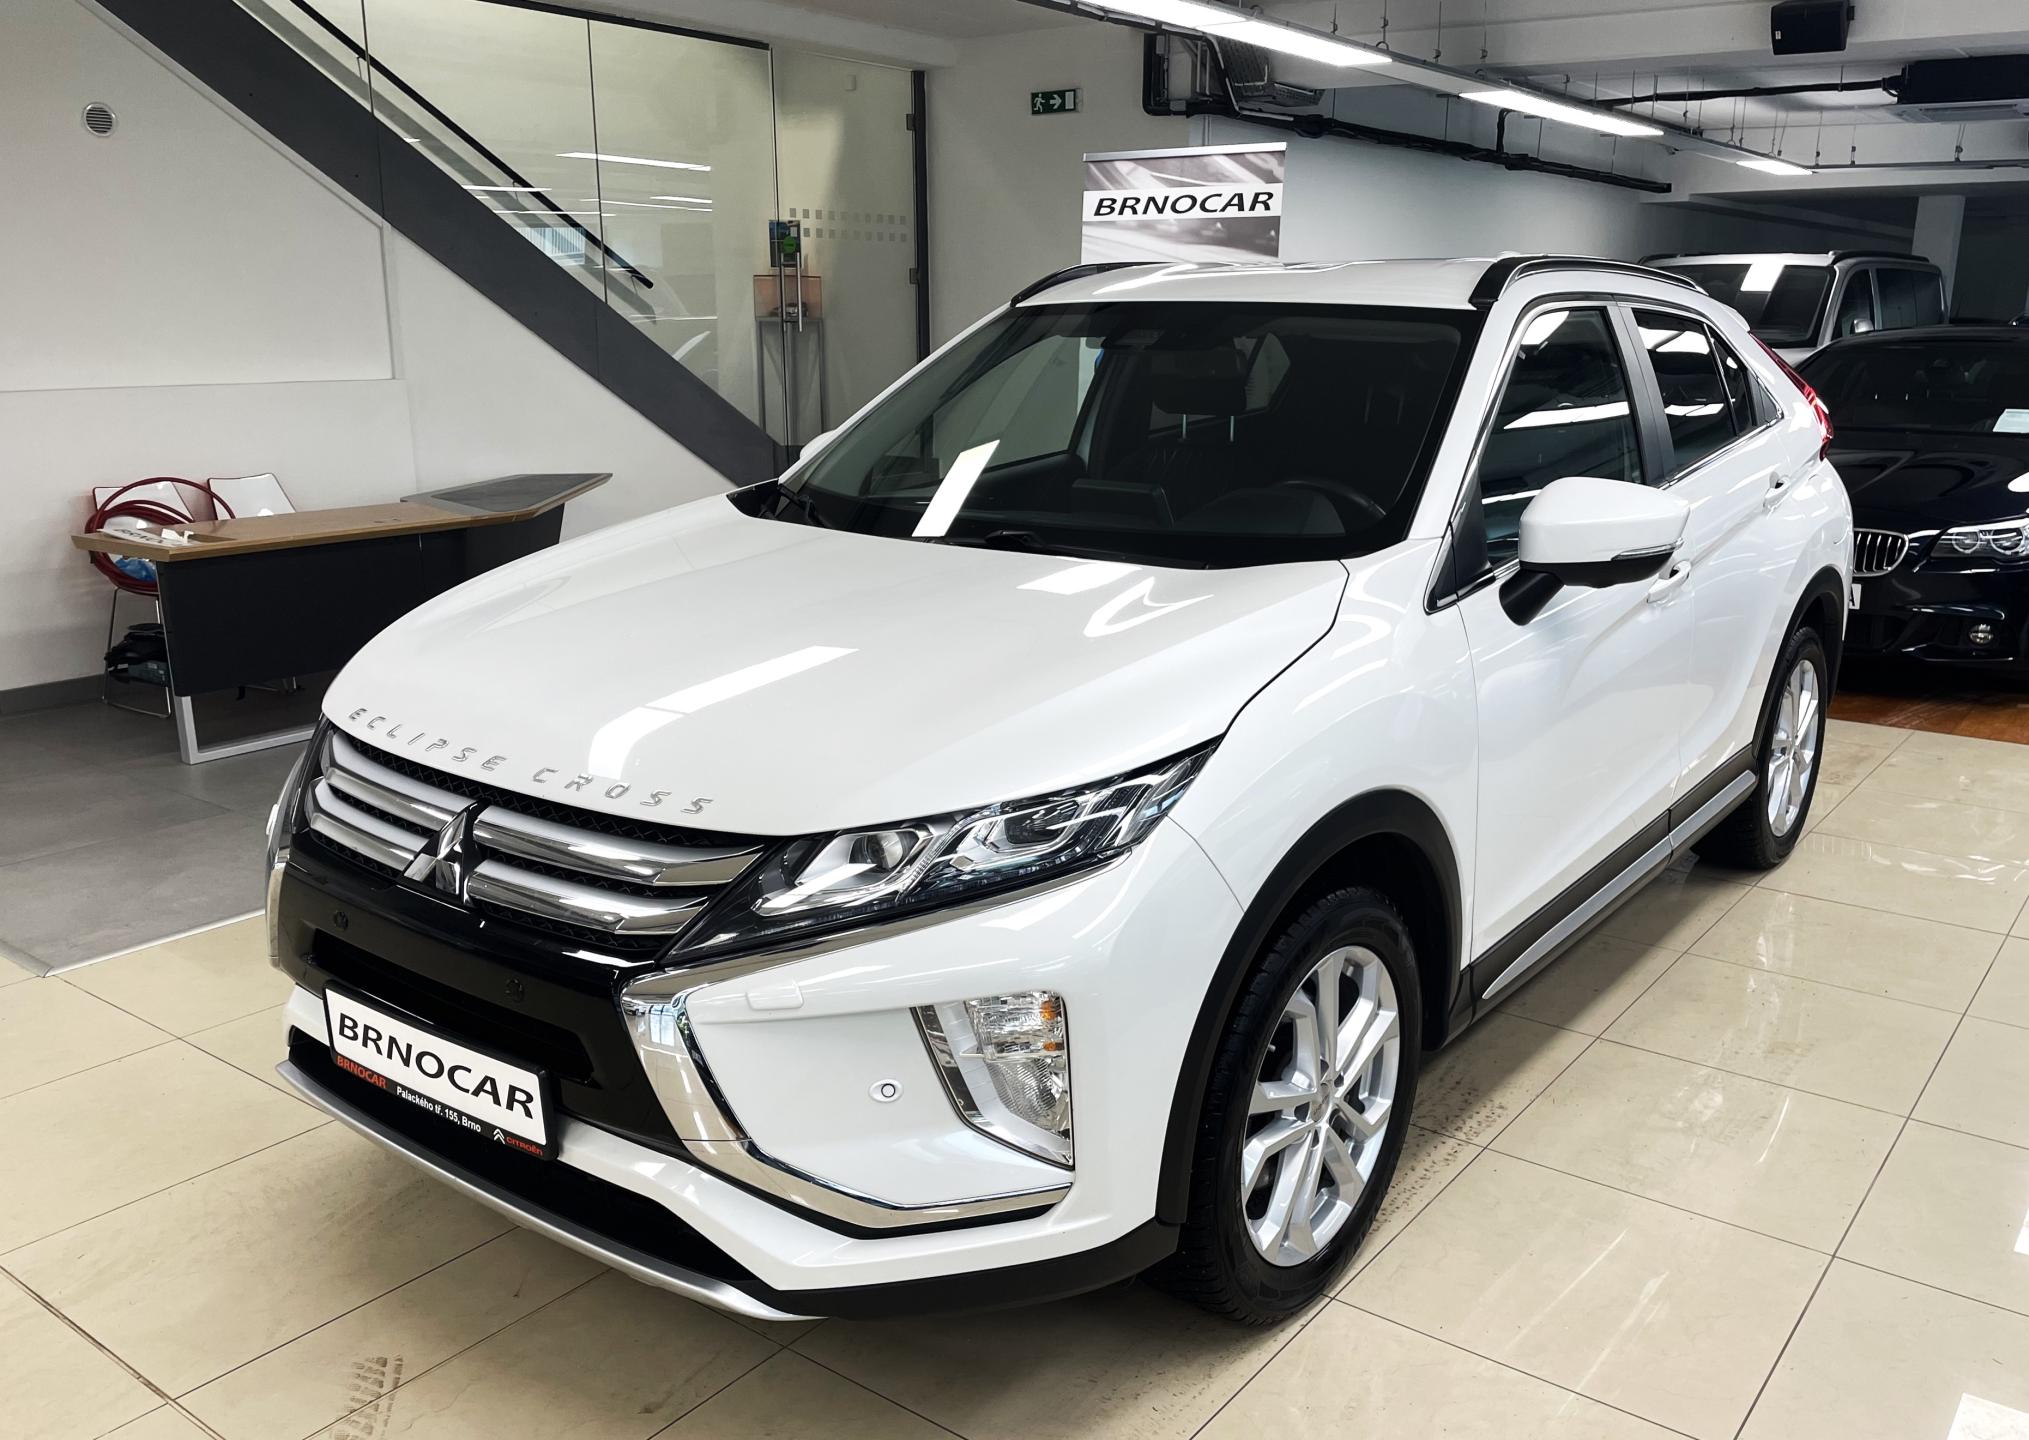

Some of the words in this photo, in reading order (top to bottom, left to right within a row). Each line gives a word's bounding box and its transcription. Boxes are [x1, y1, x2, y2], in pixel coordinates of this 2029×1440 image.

[1094, 191, 1274, 217] BRNOCAR
[348, 708, 507, 771] ECLIPSE
[532, 768, 714, 815] CROSS
[336, 1055, 387, 1089] BRNOCAR
[338, 1012, 534, 1120] BRNOCAR
[396, 1086, 434, 1111] Palackého
[445, 1108, 460, 1125] 155,
[462, 1116, 481, 1132] Brno
